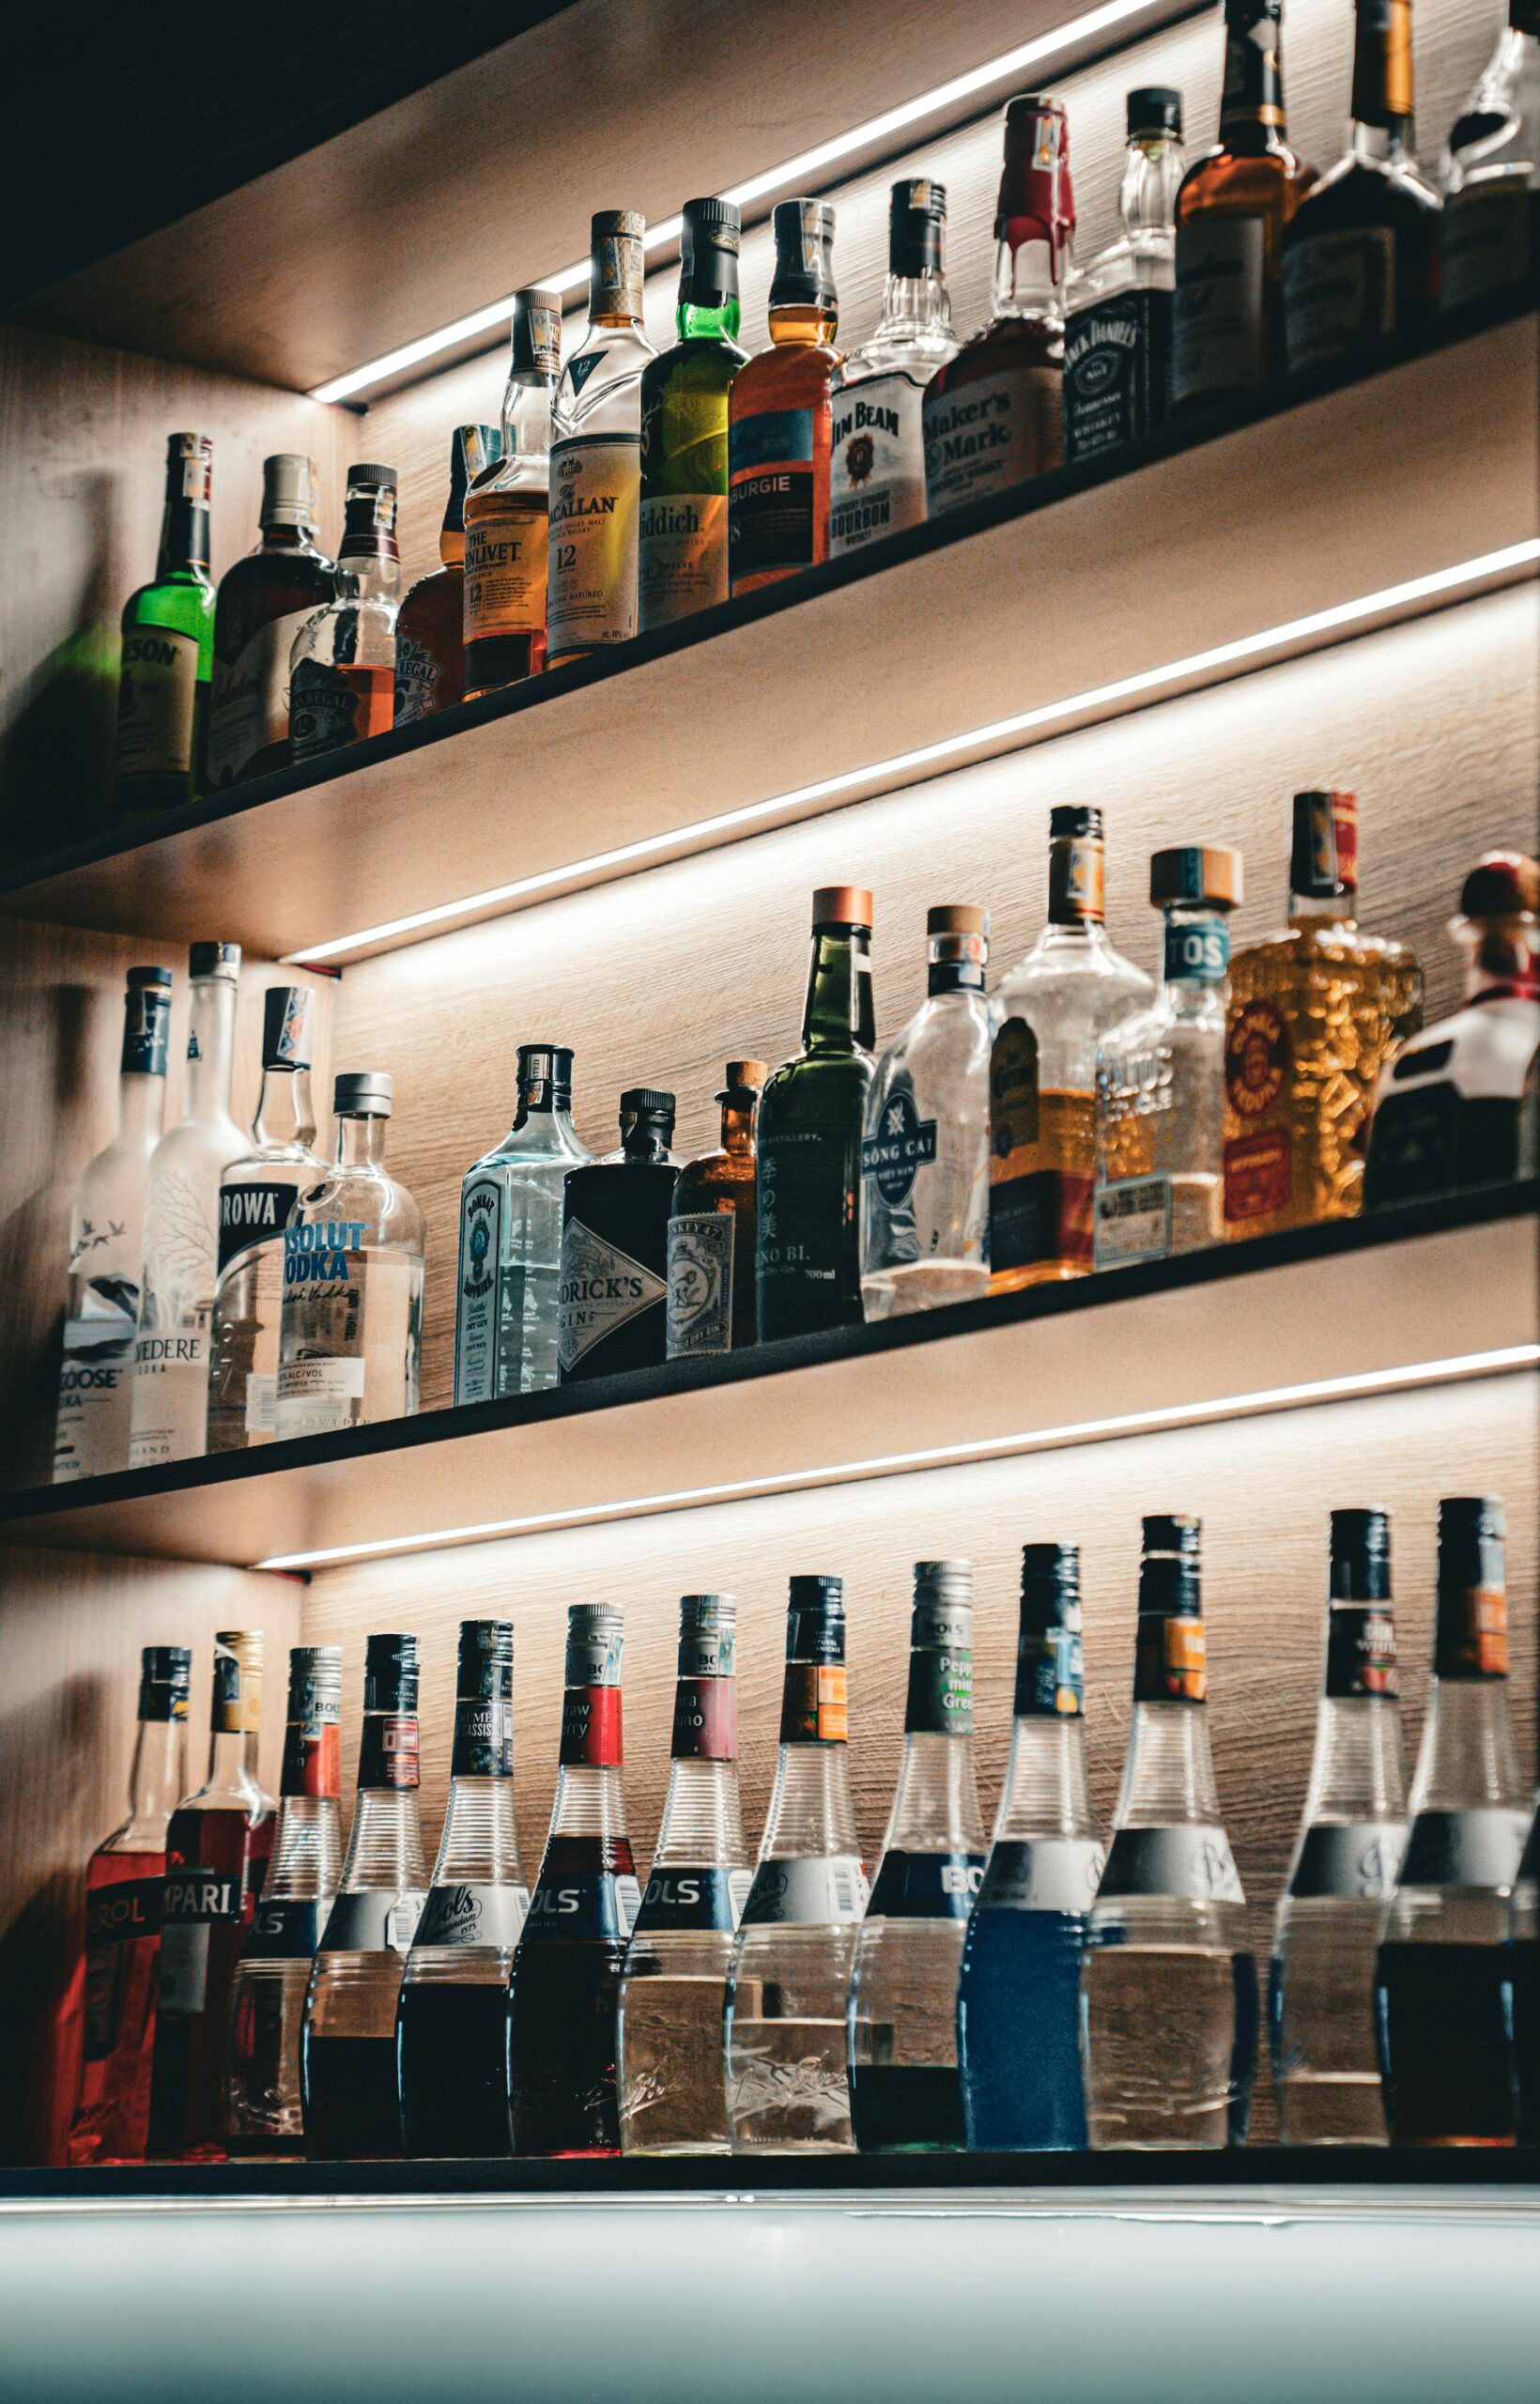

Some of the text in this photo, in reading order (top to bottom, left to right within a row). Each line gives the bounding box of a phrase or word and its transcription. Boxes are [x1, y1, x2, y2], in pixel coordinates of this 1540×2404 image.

[855, 401, 900, 438] BEAM
[943, 423, 1014, 466] Mark
[831, 502, 891, 540] BOURBON
[470, 531, 487, 548] THE
[556, 545, 577, 572] 12
[470, 582, 482, 603] 12
[399, 661, 435, 682] REGAL
